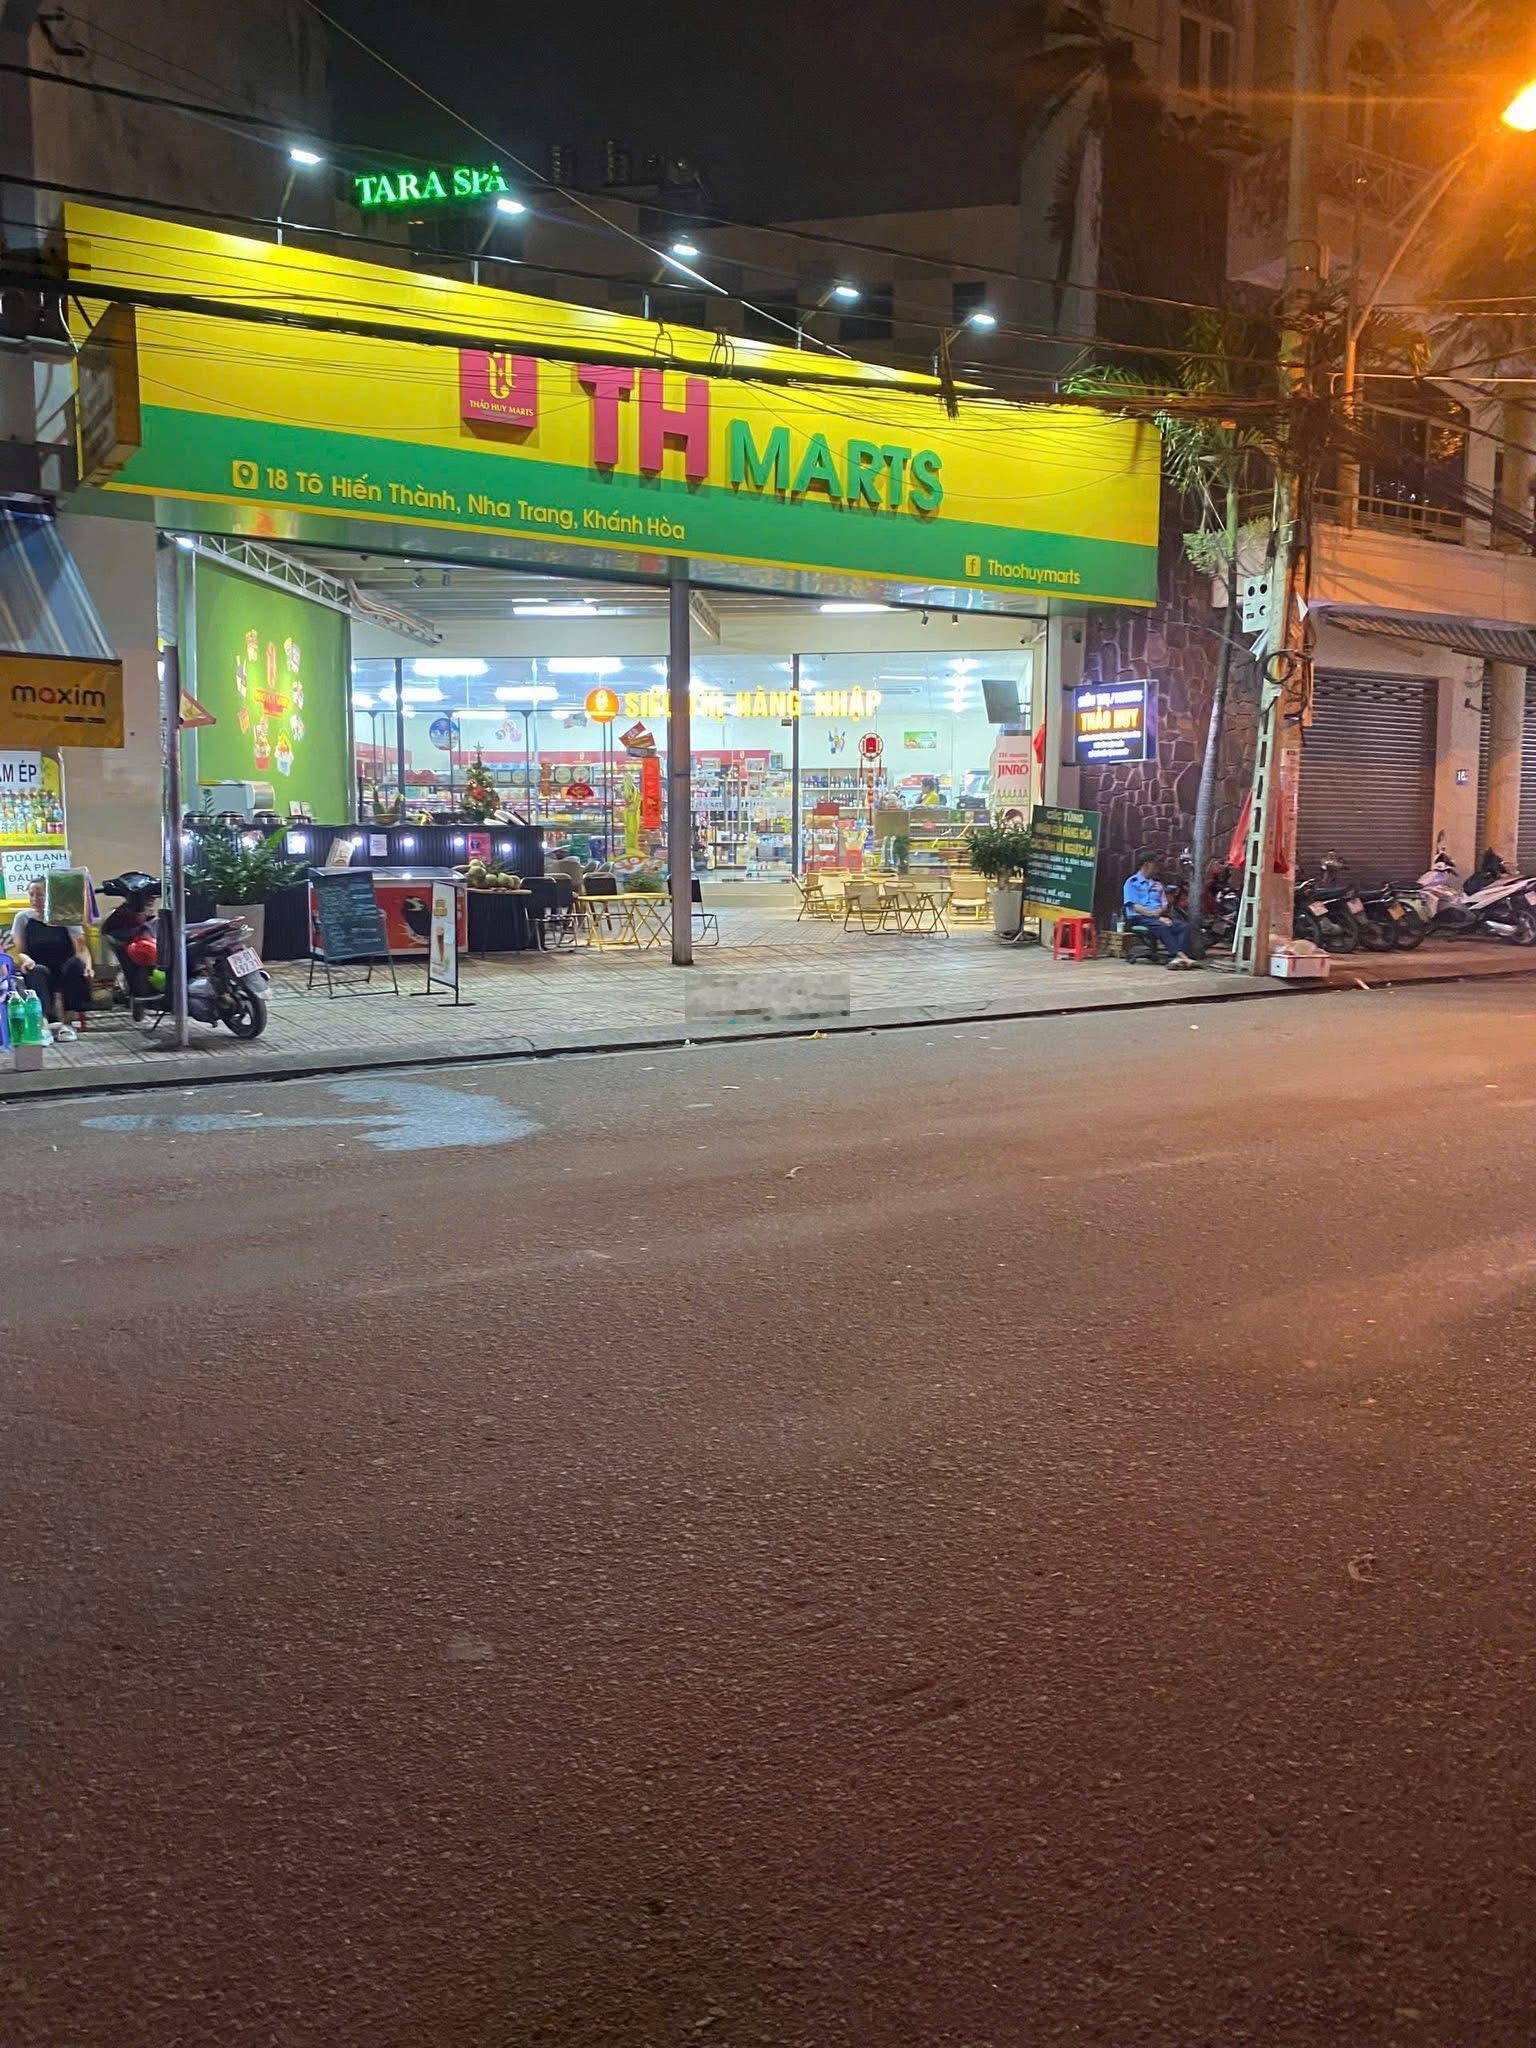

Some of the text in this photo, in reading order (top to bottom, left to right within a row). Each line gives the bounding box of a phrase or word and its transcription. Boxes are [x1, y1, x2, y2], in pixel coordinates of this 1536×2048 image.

[355, 171, 447, 204] TARA
[490, 403, 507, 413] HUY
[508, 406, 534, 417] MARTS
[576, 362, 943, 511] TH MARTS
[266, 467, 685, 540] 18 Tô Hiến Thành, Nha Trang, Khánh Hòa
[988, 559, 1081, 585] Thaohuymarts
[11, 684, 106, 707] maxim
[19, 760, 37, 783] ÉP
[997, 764, 1029, 779] JINRO
